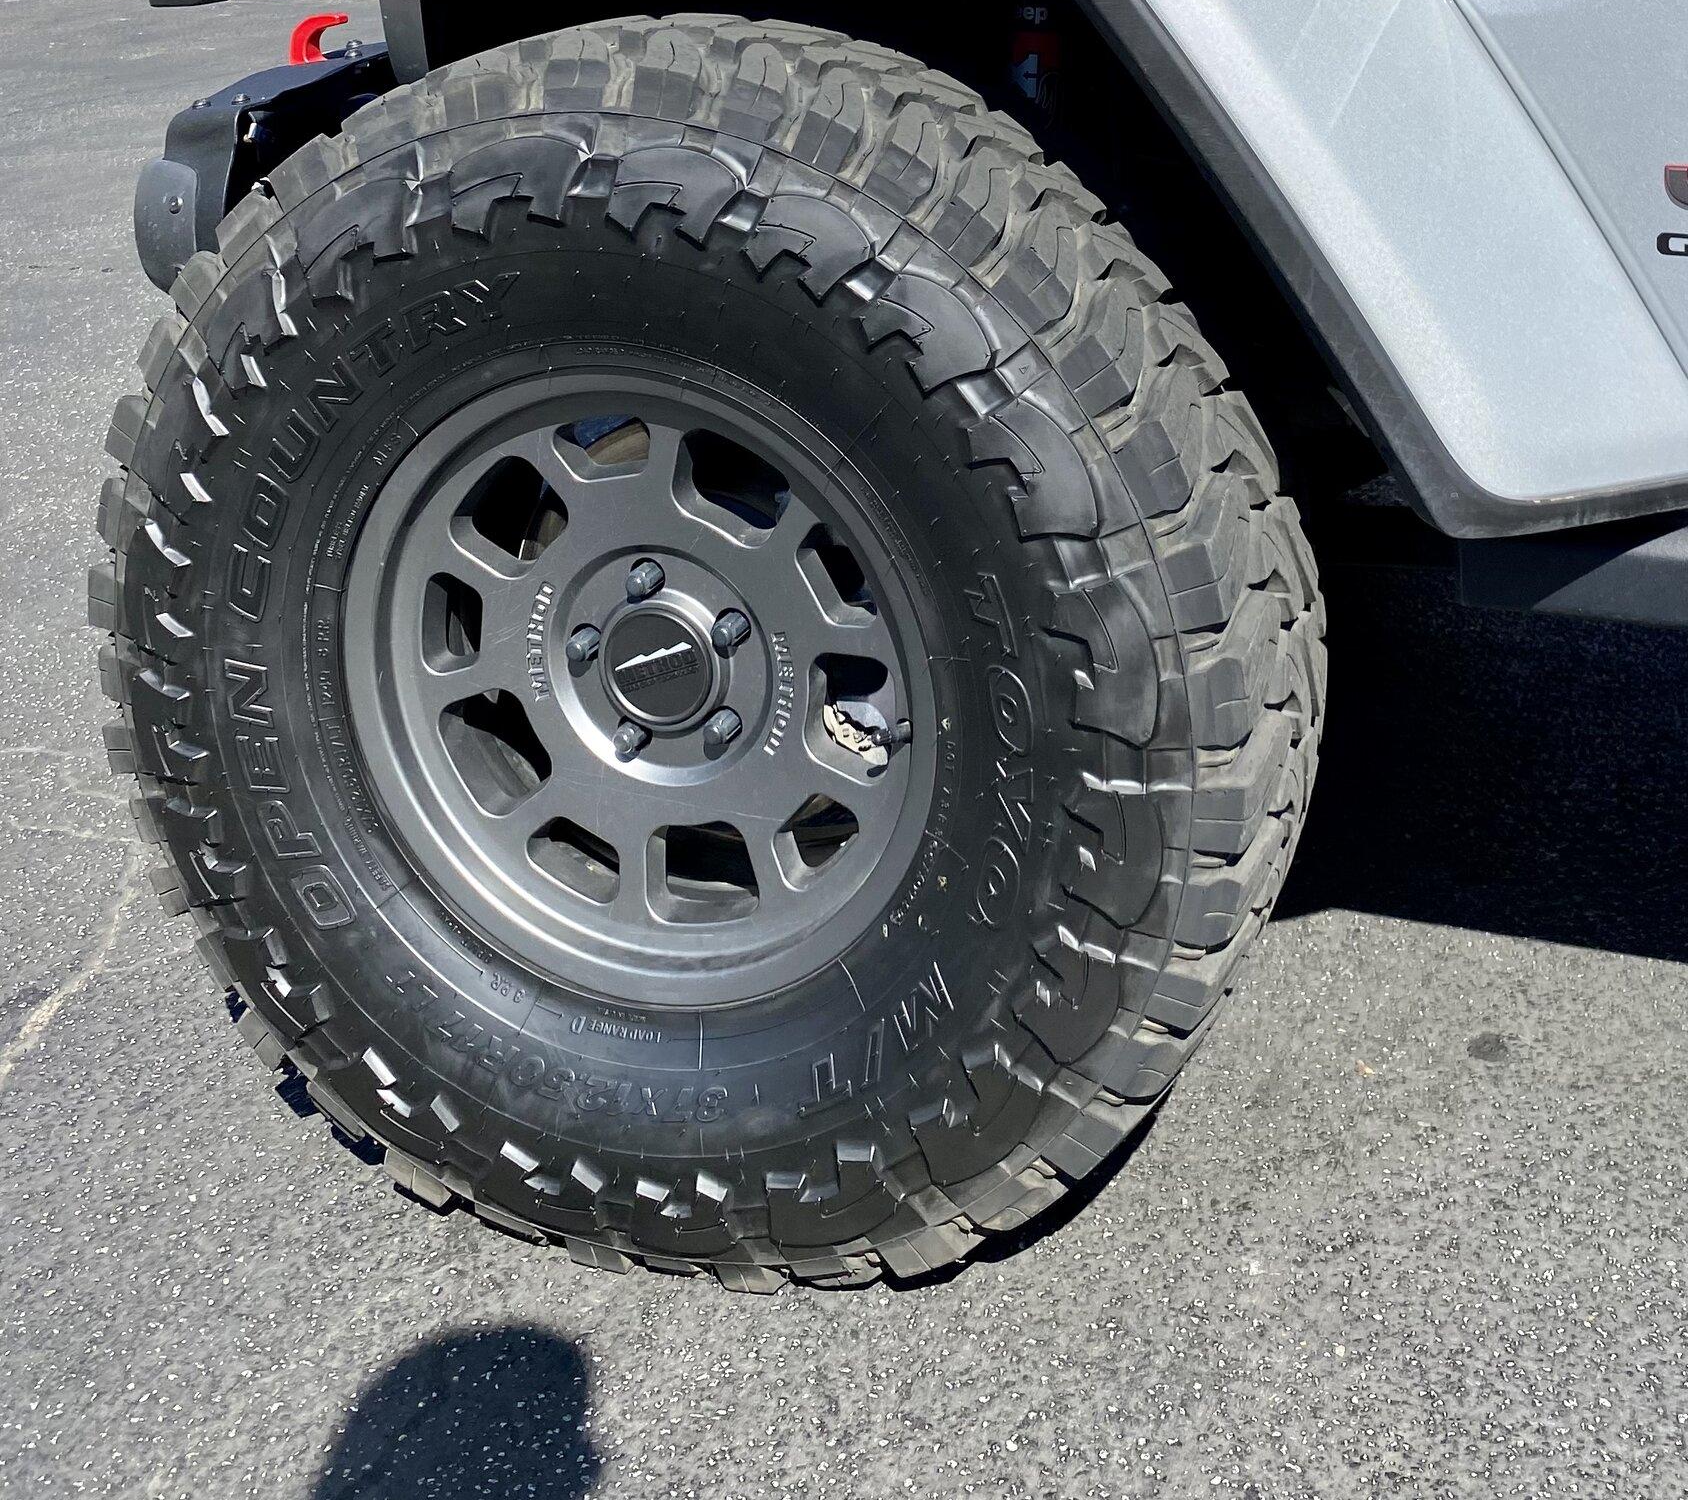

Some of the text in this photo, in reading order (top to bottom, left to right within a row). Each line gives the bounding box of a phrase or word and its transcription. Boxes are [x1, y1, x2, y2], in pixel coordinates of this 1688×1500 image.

[227, 270, 522, 620] COUNTRY
[526, 580, 556, 703] METHOD
[224, 657, 358, 931] OPEN
[962, 570, 1035, 926] TOYO
[568, 1014, 588, 1035] D
[587, 1017, 630, 1040] RANGE
[629, 1027, 663, 1045] LOAD
[797, 961, 956, 1109] M/T
